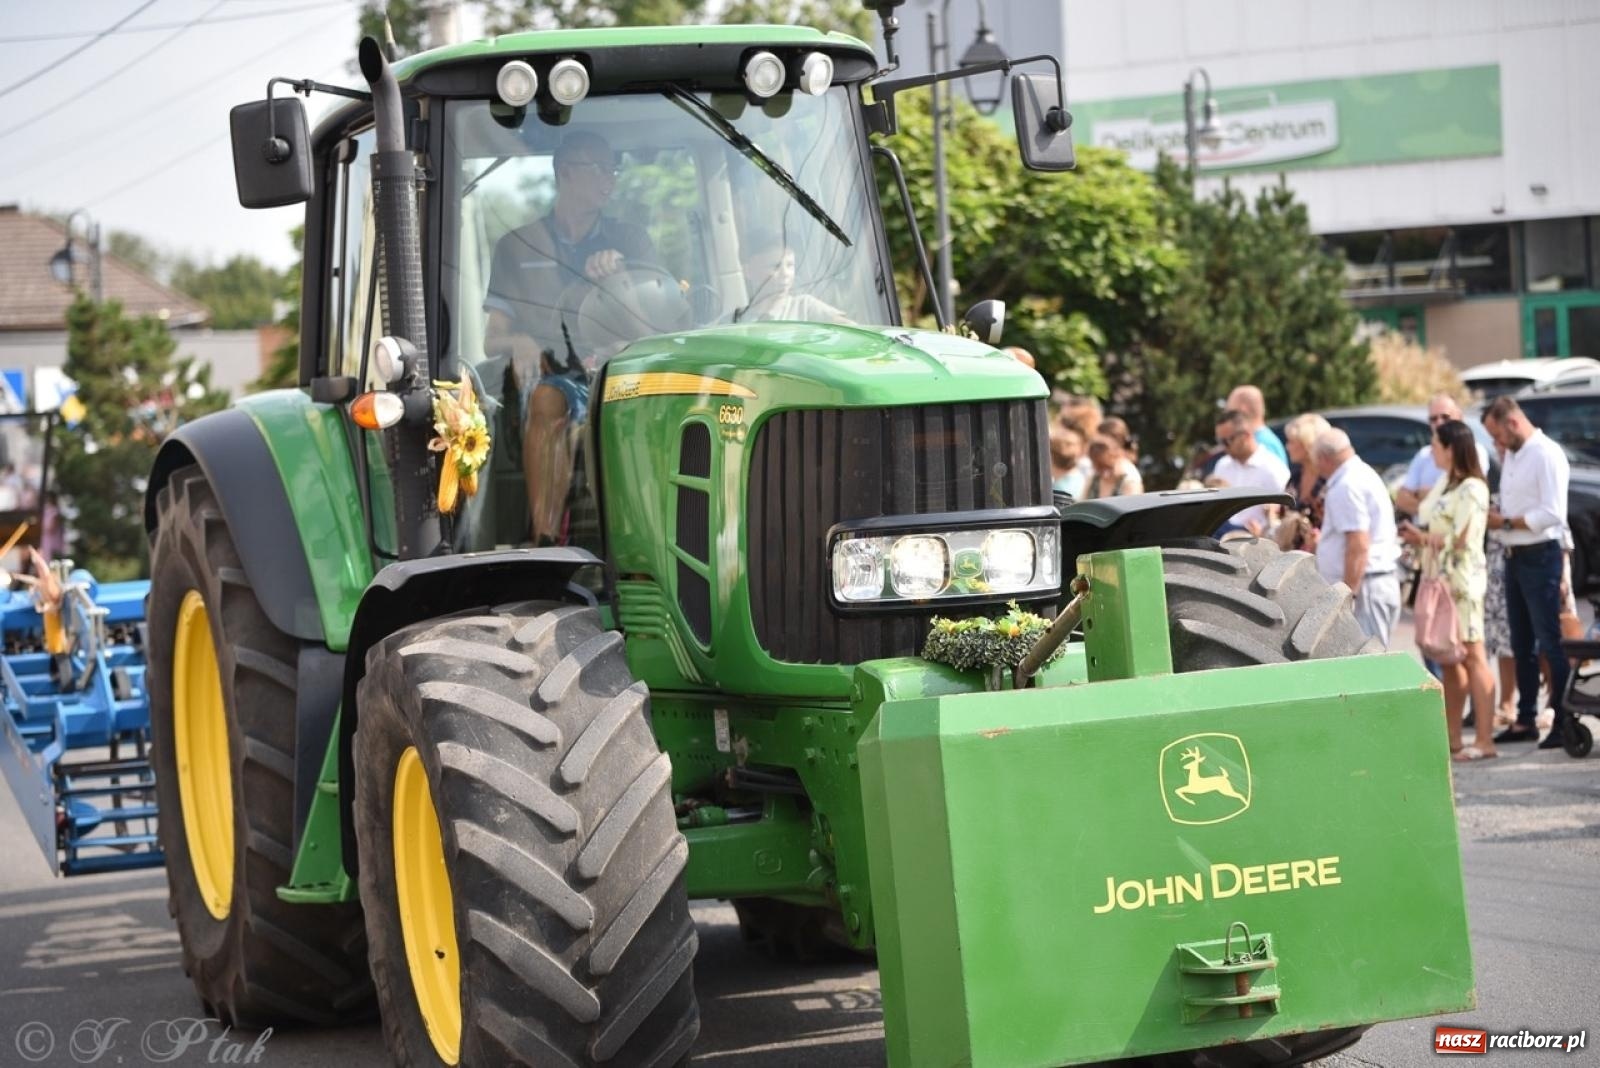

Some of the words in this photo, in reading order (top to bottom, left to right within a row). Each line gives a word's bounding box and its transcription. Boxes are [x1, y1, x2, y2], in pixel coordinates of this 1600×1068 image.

[1226, 118, 1327, 144] Centrum
[719, 404, 744, 425] 6630
[1093, 873, 1204, 914] JOHN
[1210, 856, 1342, 899] DEERE
